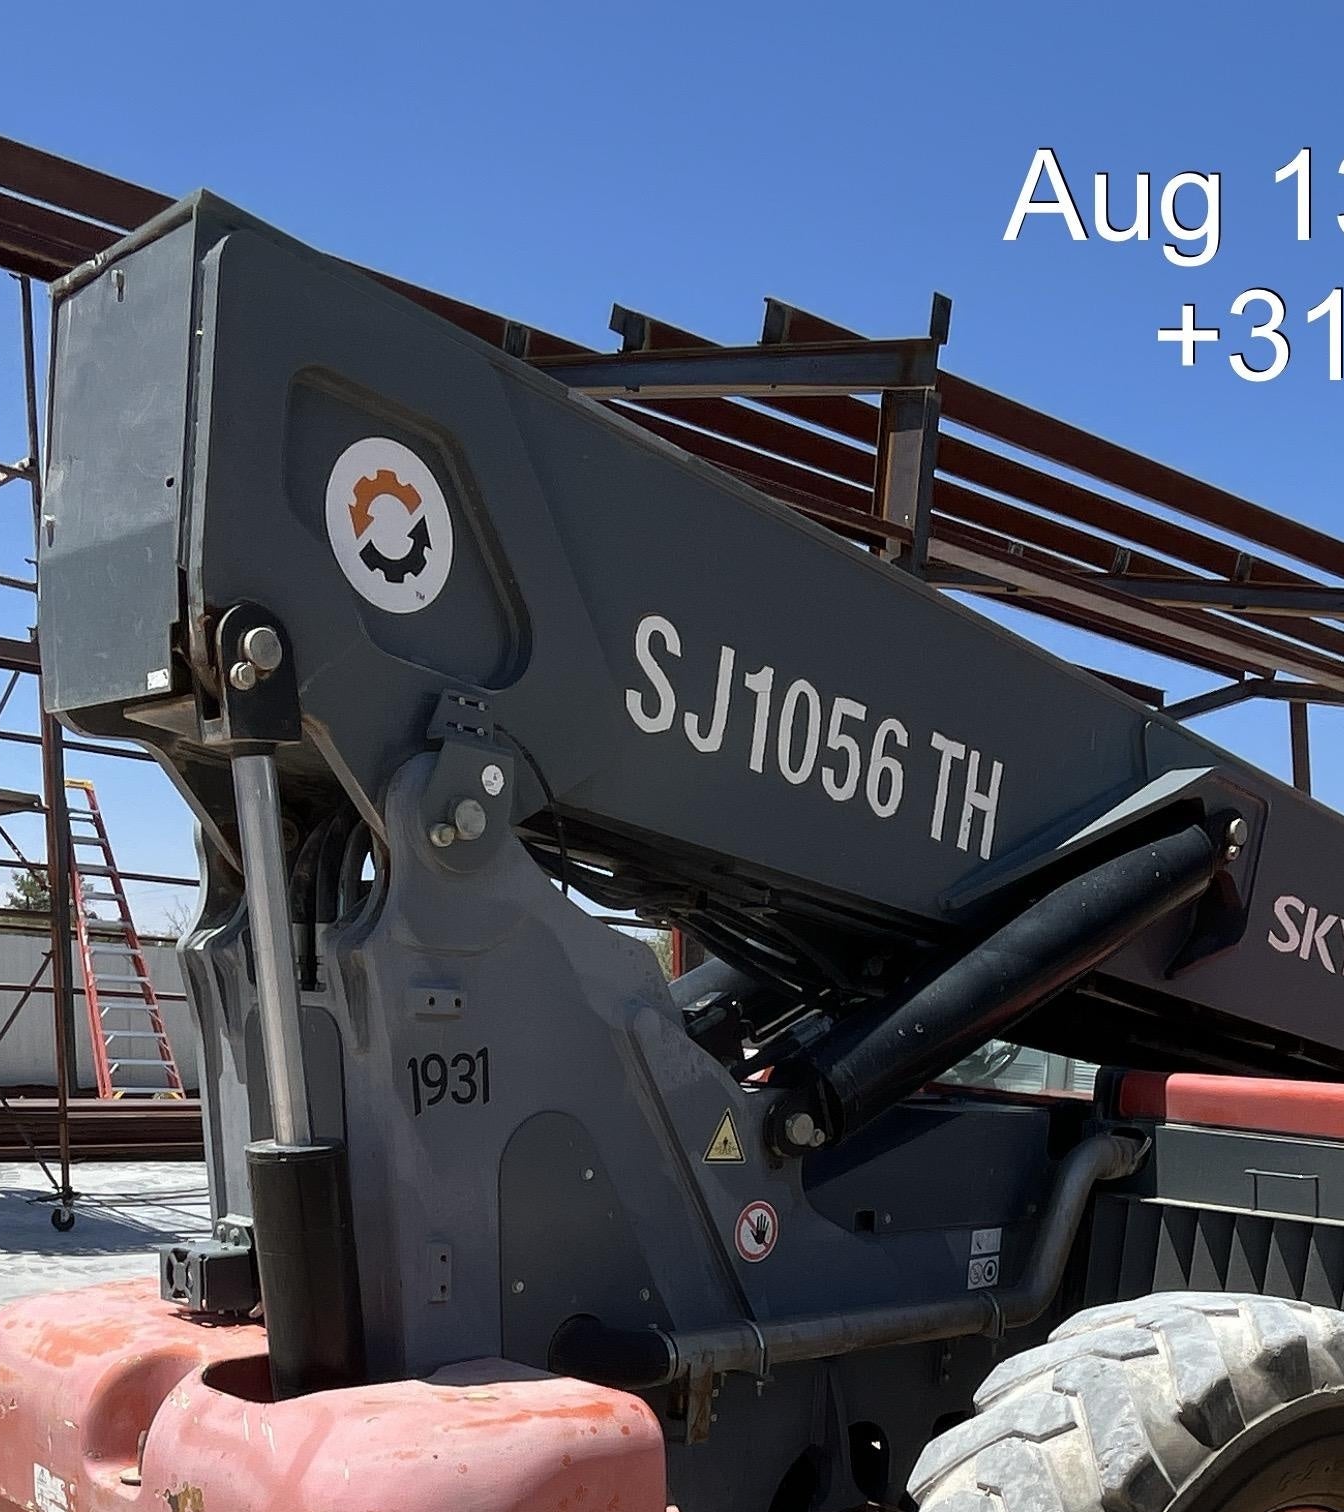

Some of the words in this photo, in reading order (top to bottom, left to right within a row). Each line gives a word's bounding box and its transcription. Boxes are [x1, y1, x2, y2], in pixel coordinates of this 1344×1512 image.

[625, 615, 908, 818] SJ1056
[930, 731, 1004, 861] TH
[407, 1046, 490, 1116] 1931
